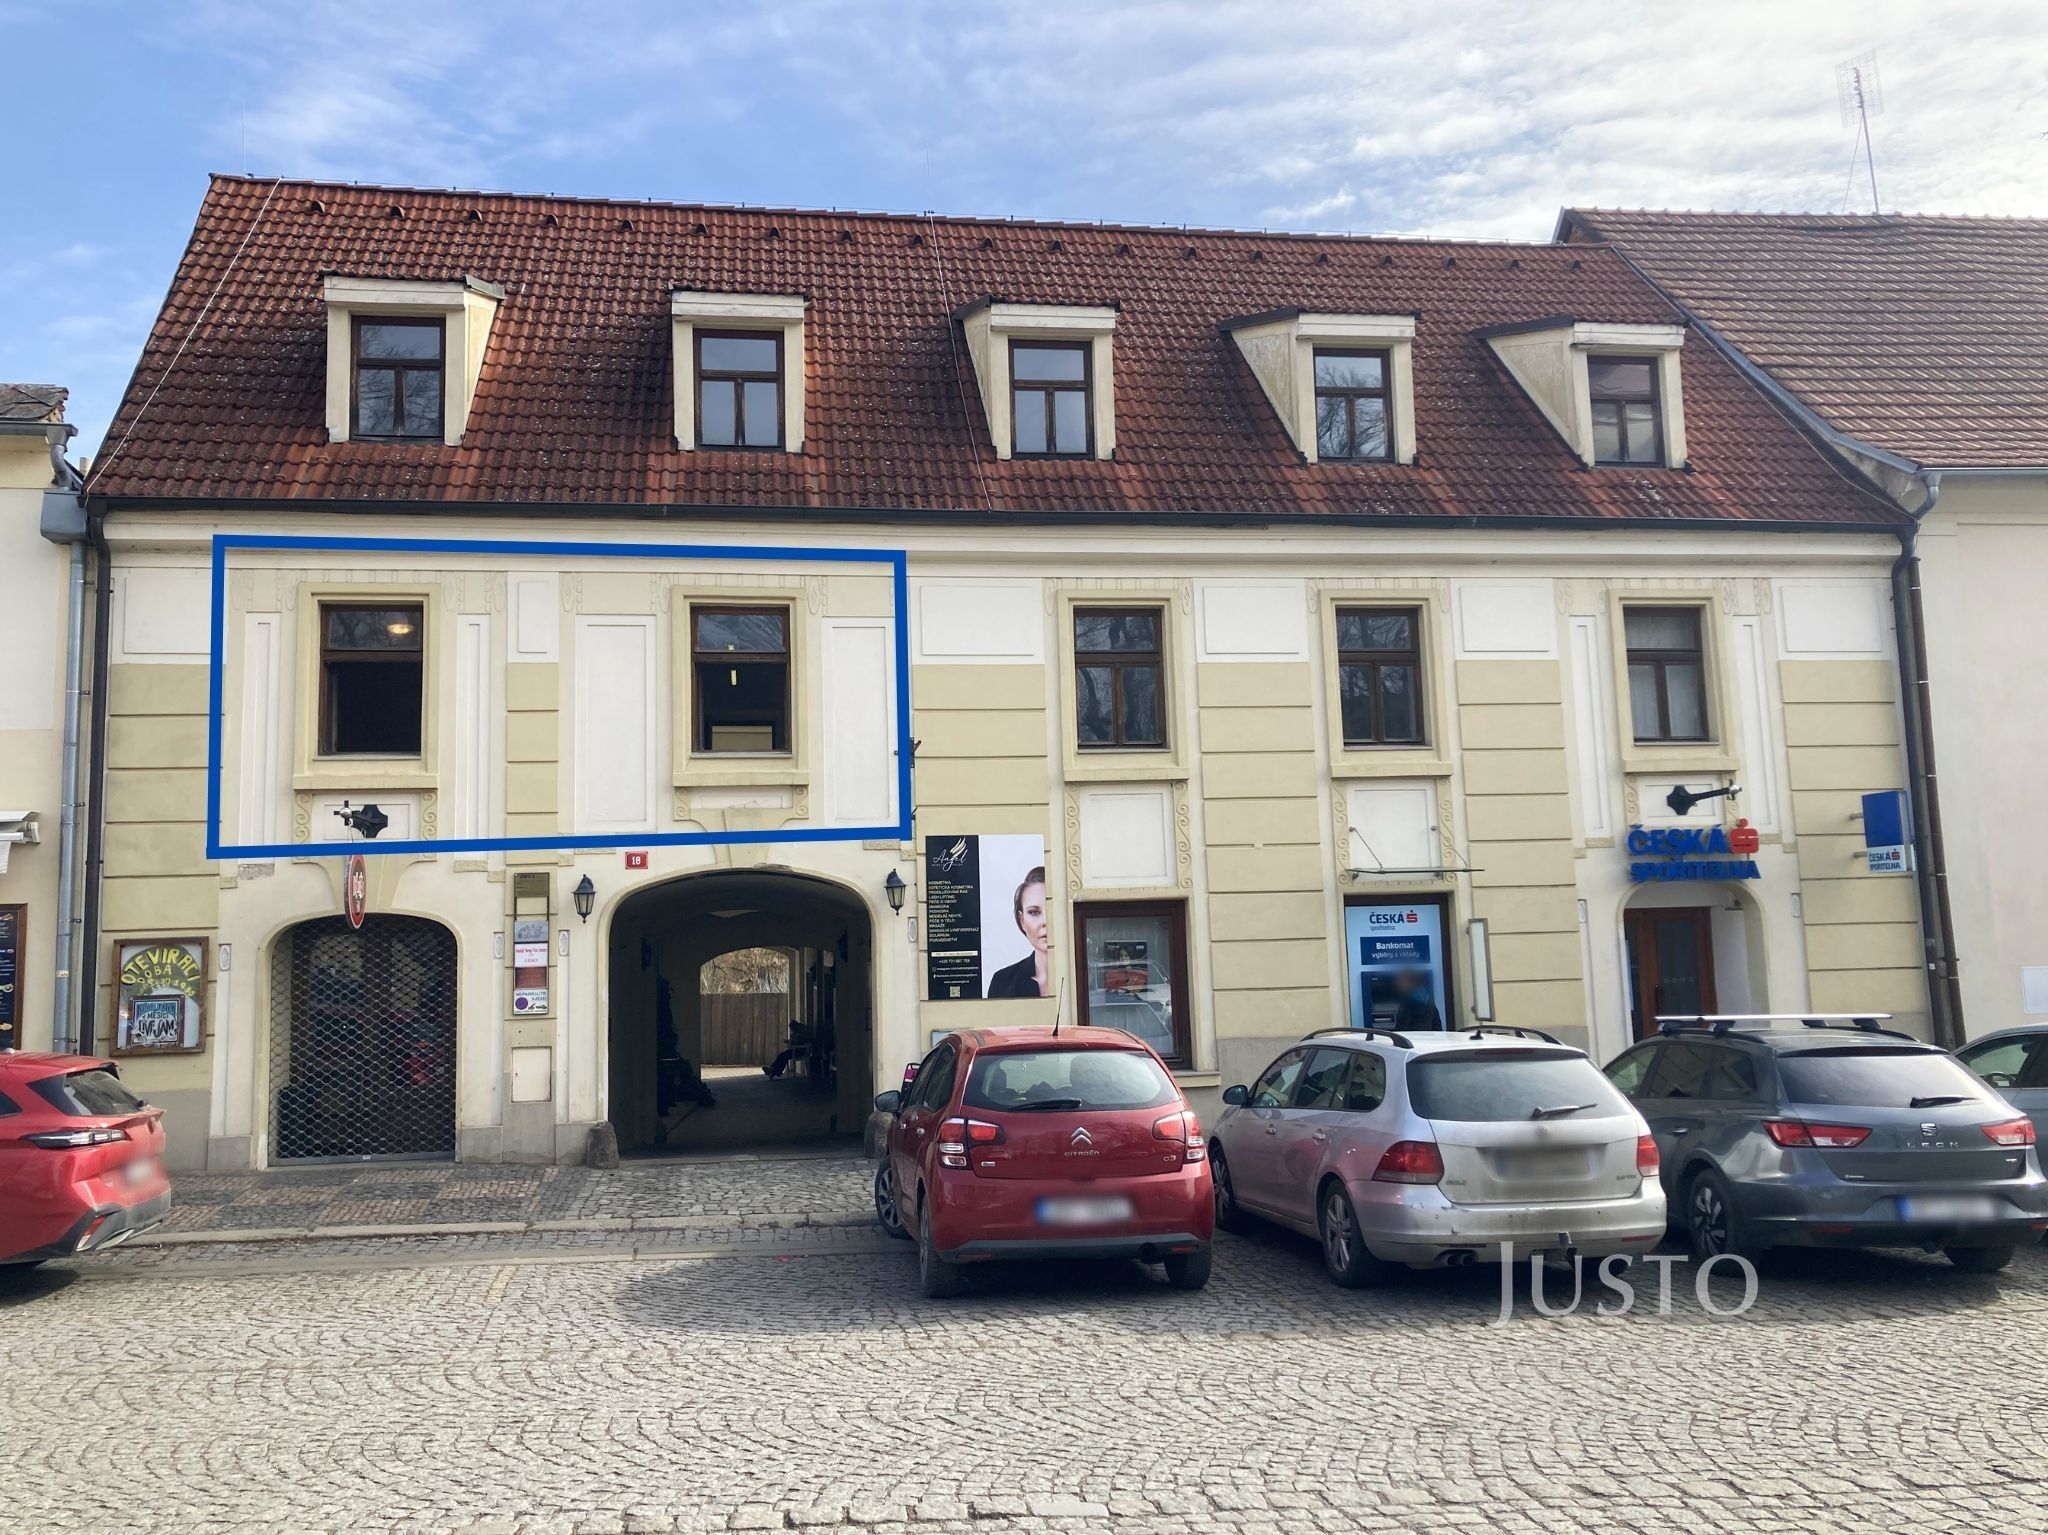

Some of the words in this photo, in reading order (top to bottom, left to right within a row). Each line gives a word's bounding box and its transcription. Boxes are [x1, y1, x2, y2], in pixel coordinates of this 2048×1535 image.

[1628, 824, 1727, 855] ČESKÁ
[632, 856, 641, 865] 18
[932, 849, 968, 872] Angel
[1869, 852, 1891, 862] ČESKÁ
[1369, 911, 1405, 924] ČESKÁ
[1376, 942, 1414, 950] Bankomat
